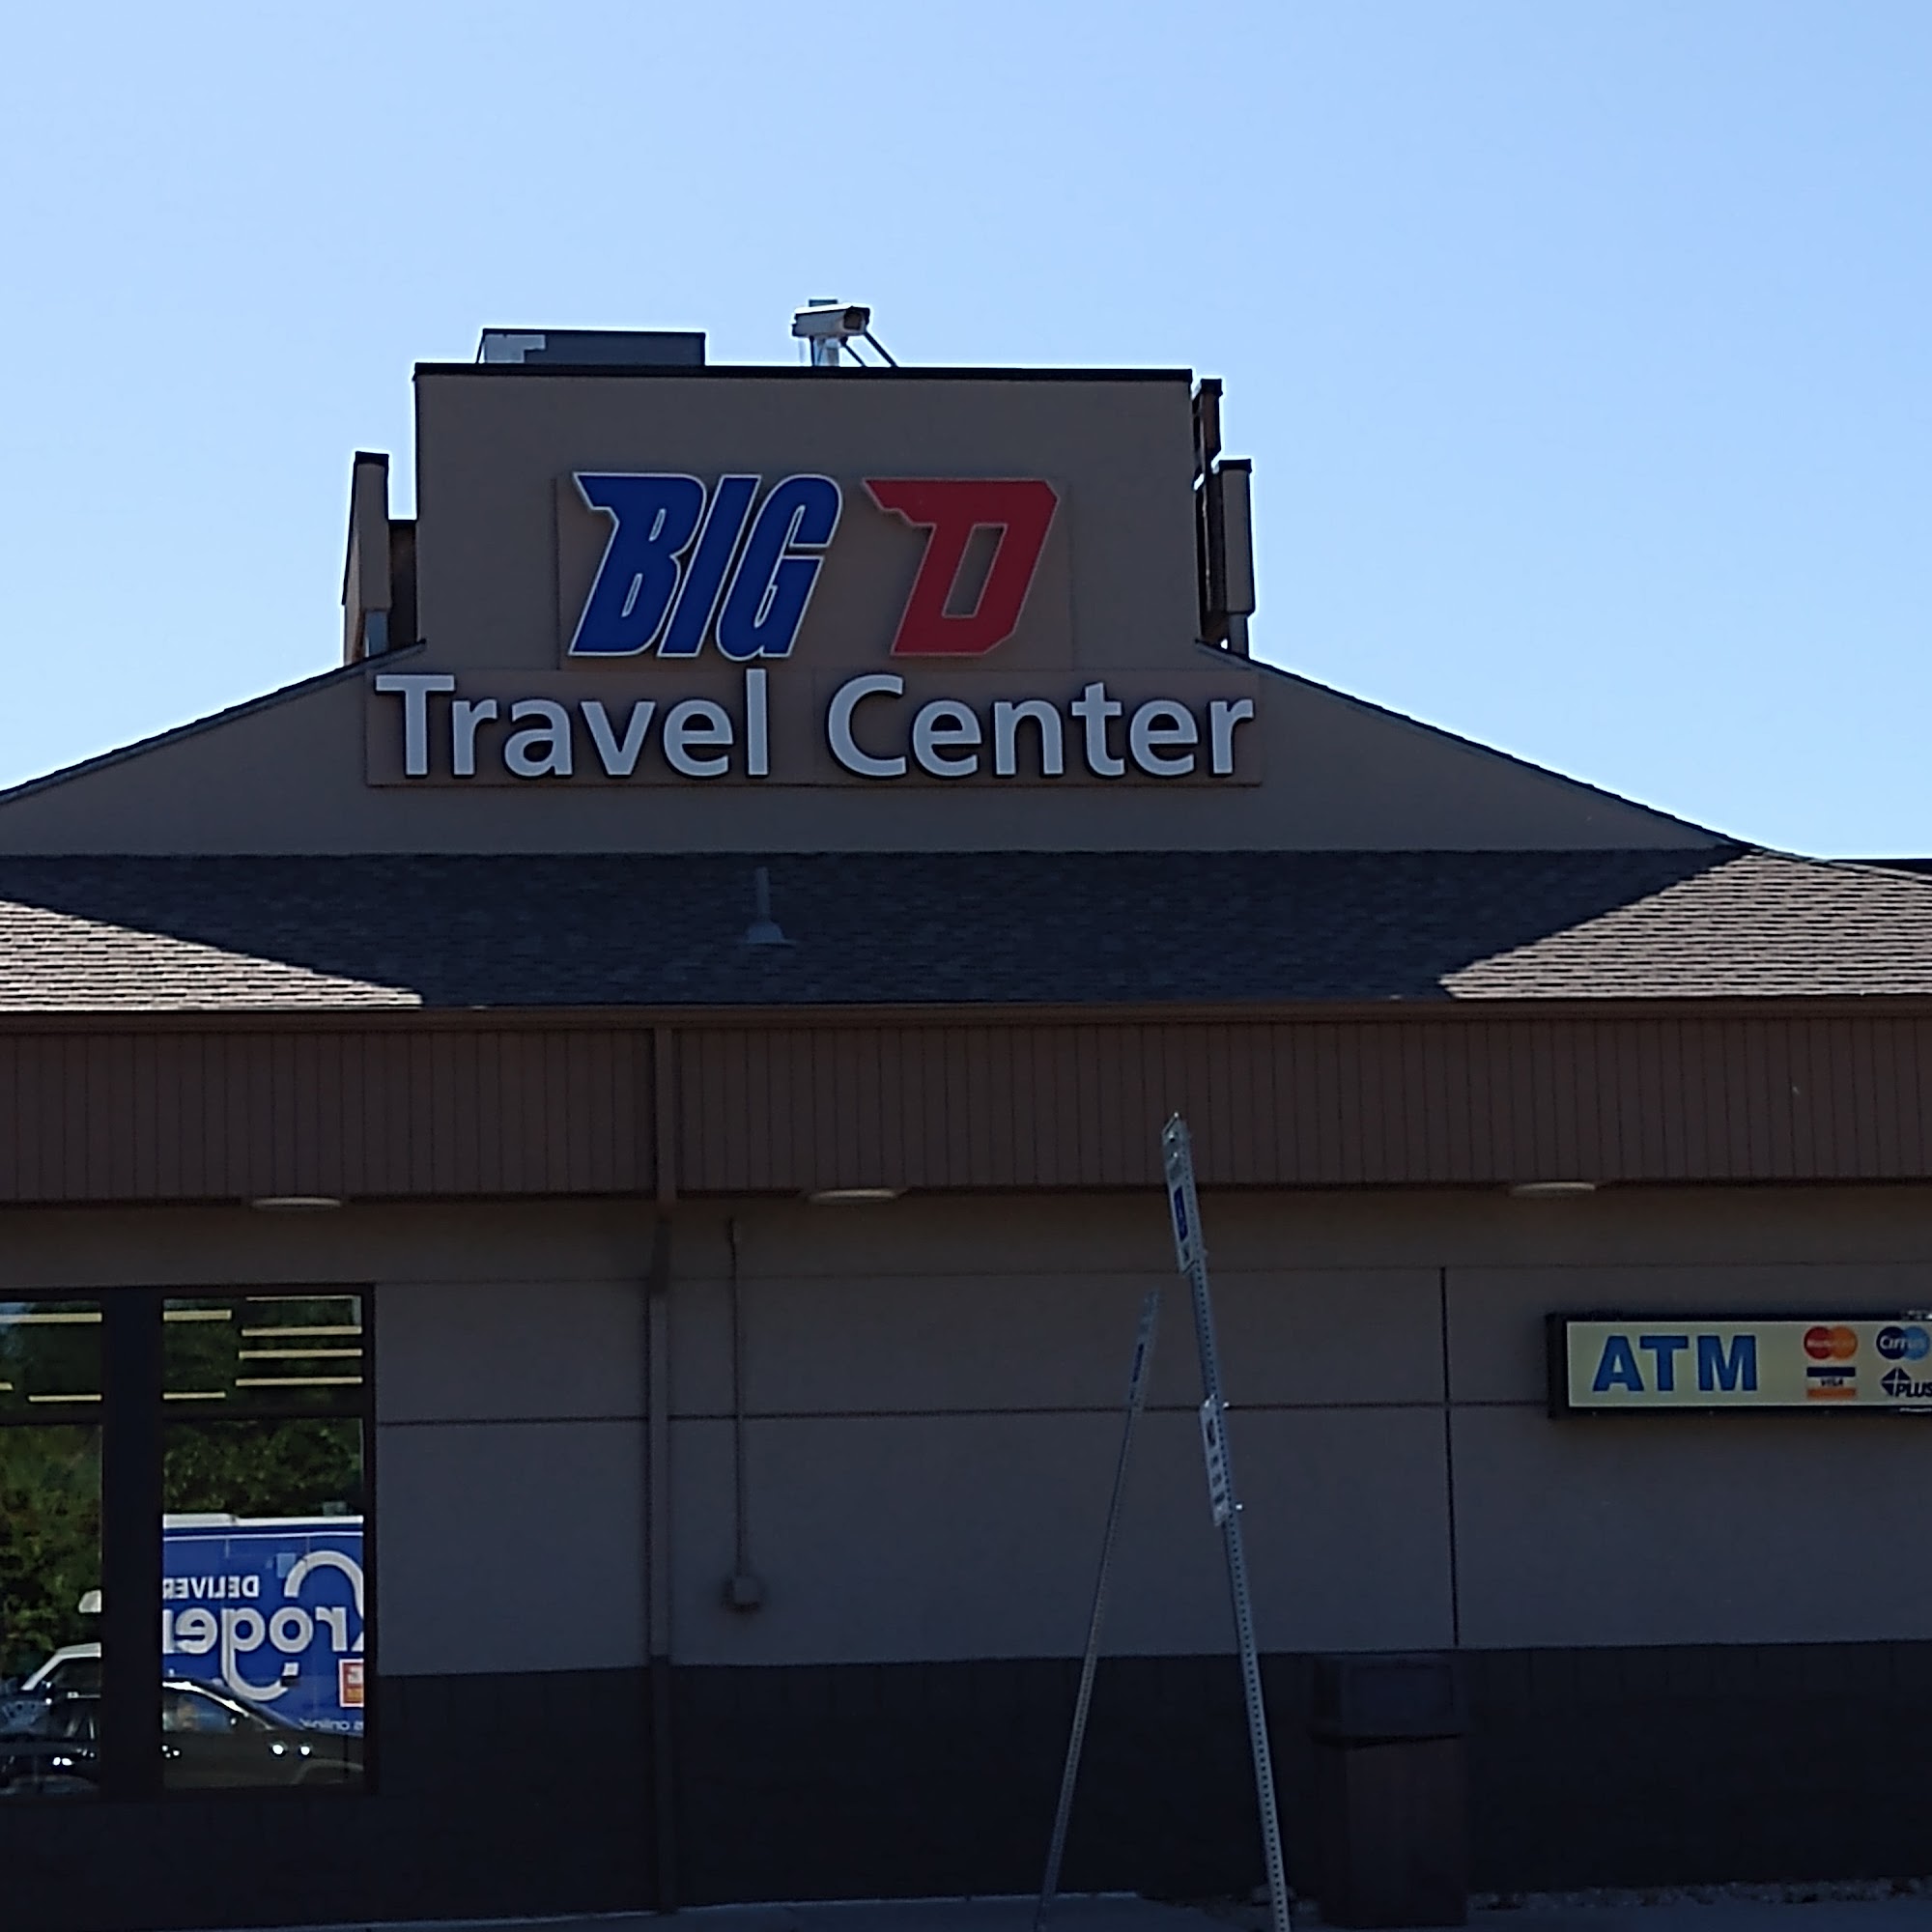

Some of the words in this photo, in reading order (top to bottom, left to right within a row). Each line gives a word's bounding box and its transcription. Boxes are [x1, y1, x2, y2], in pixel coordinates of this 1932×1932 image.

[568, 471, 843, 662] BIG
[861, 477, 1059, 657] D
[376, 668, 769, 779] Travel
[825, 672, 1254, 779] Center
[1592, 1334, 1758, 1392] ATM
[1895, 1379, 1932, 1398] PLUS
